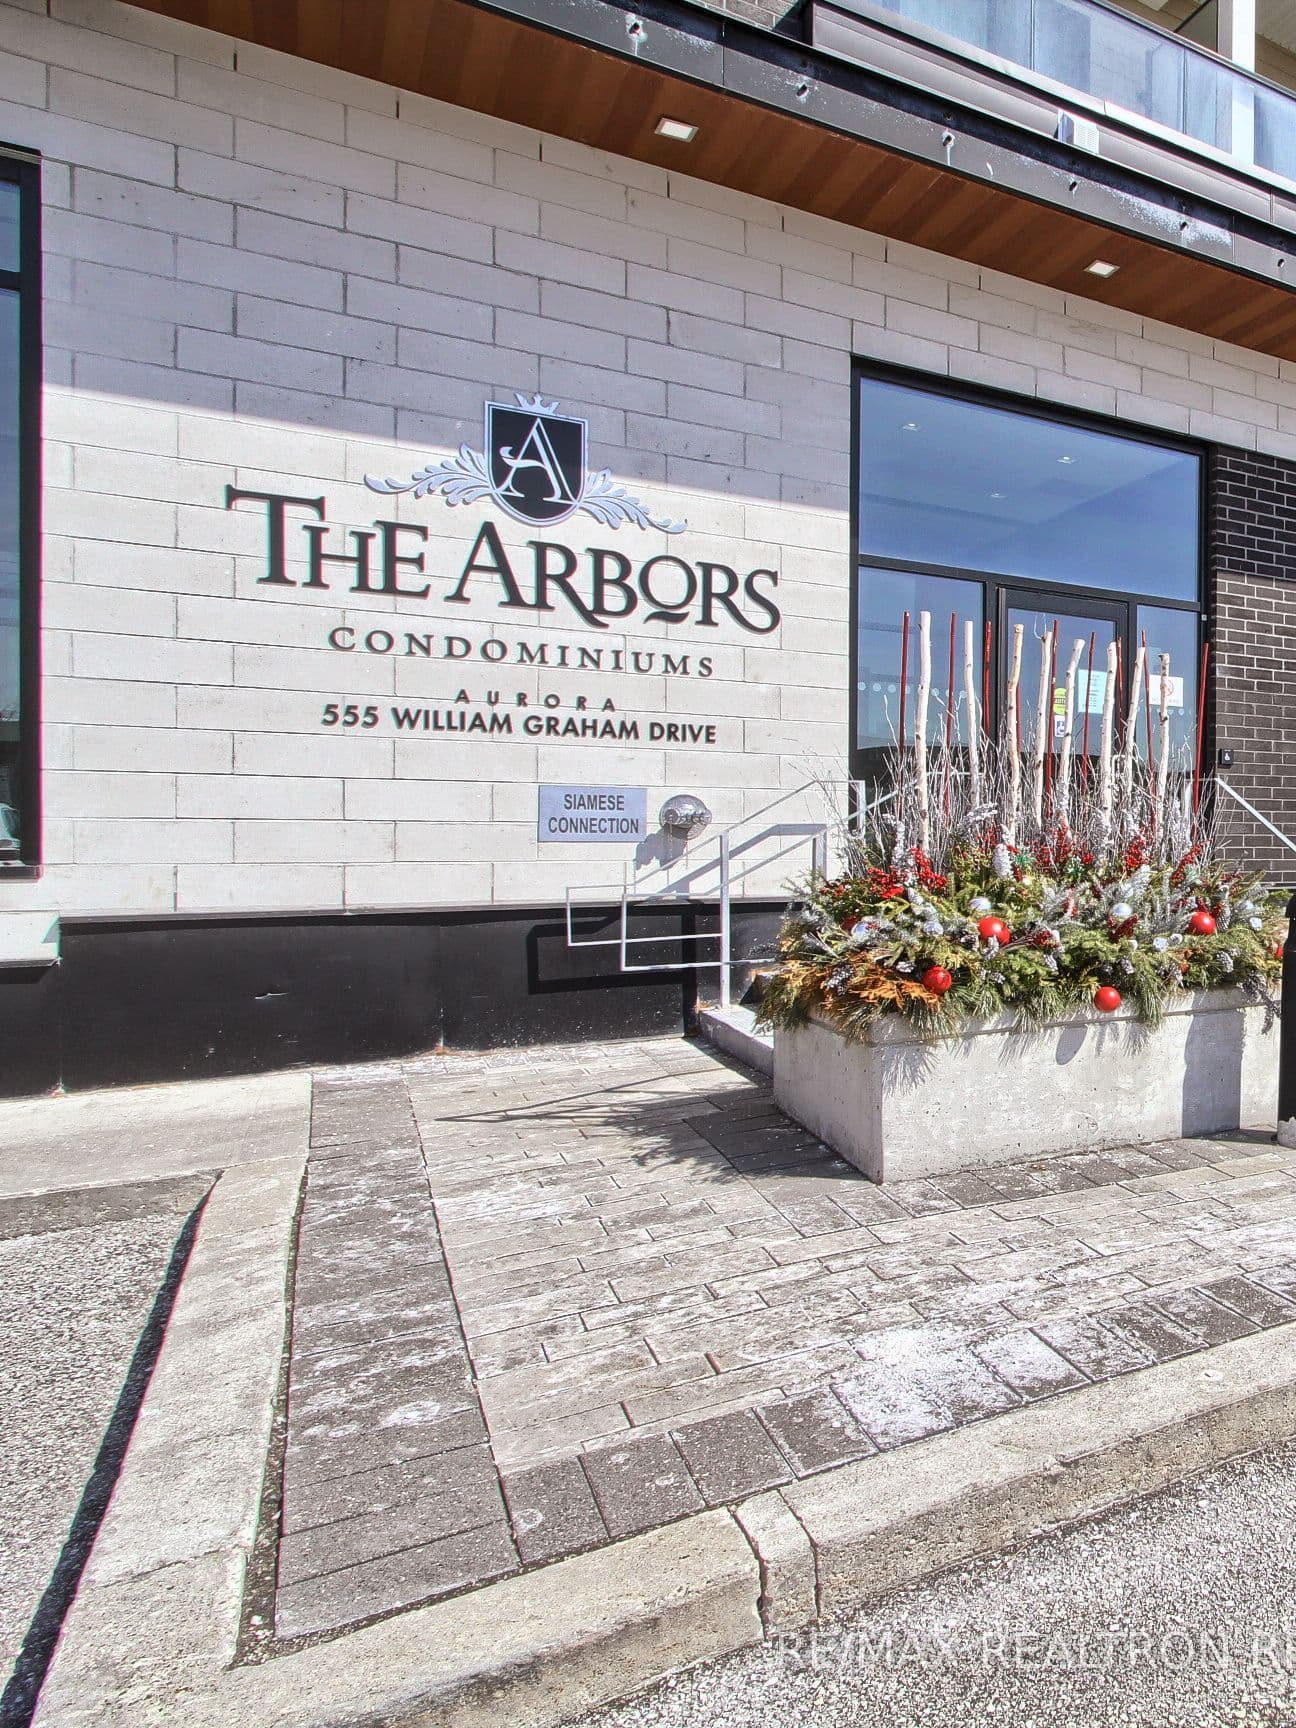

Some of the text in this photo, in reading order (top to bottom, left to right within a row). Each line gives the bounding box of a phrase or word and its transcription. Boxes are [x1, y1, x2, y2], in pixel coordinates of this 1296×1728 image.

[497, 417, 578, 505] A
[224, 484, 782, 635] THE ARBORS
[328, 626, 714, 678] CONDOMINIUMS
[454, 689, 616, 712] AURORA
[321, 703, 716, 745] 555 WILLIAM GRAHAM DRIVE
[563, 793, 625, 811] SIAMESE
[548, 816, 639, 834] CONNECTION
